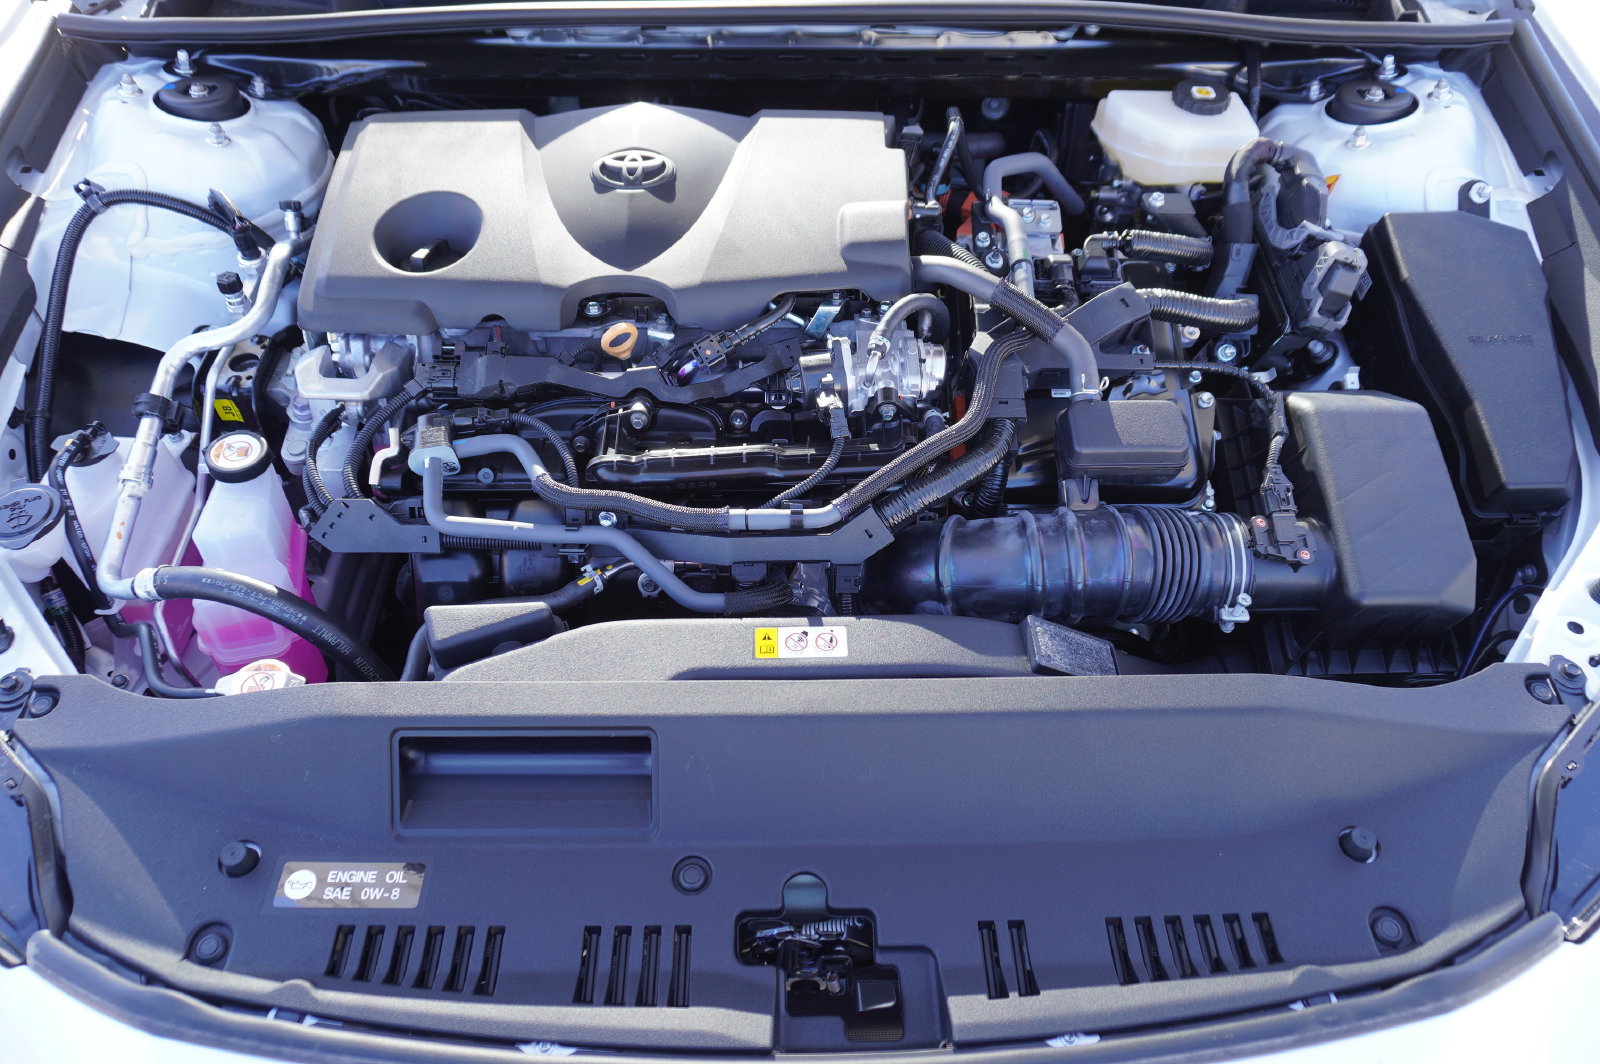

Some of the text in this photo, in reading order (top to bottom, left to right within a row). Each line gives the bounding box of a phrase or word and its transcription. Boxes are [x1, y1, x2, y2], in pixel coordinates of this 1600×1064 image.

[326, 870, 408, 884] ENGINE OIL
[323, 886, 401, 900] SAE 0W-8
